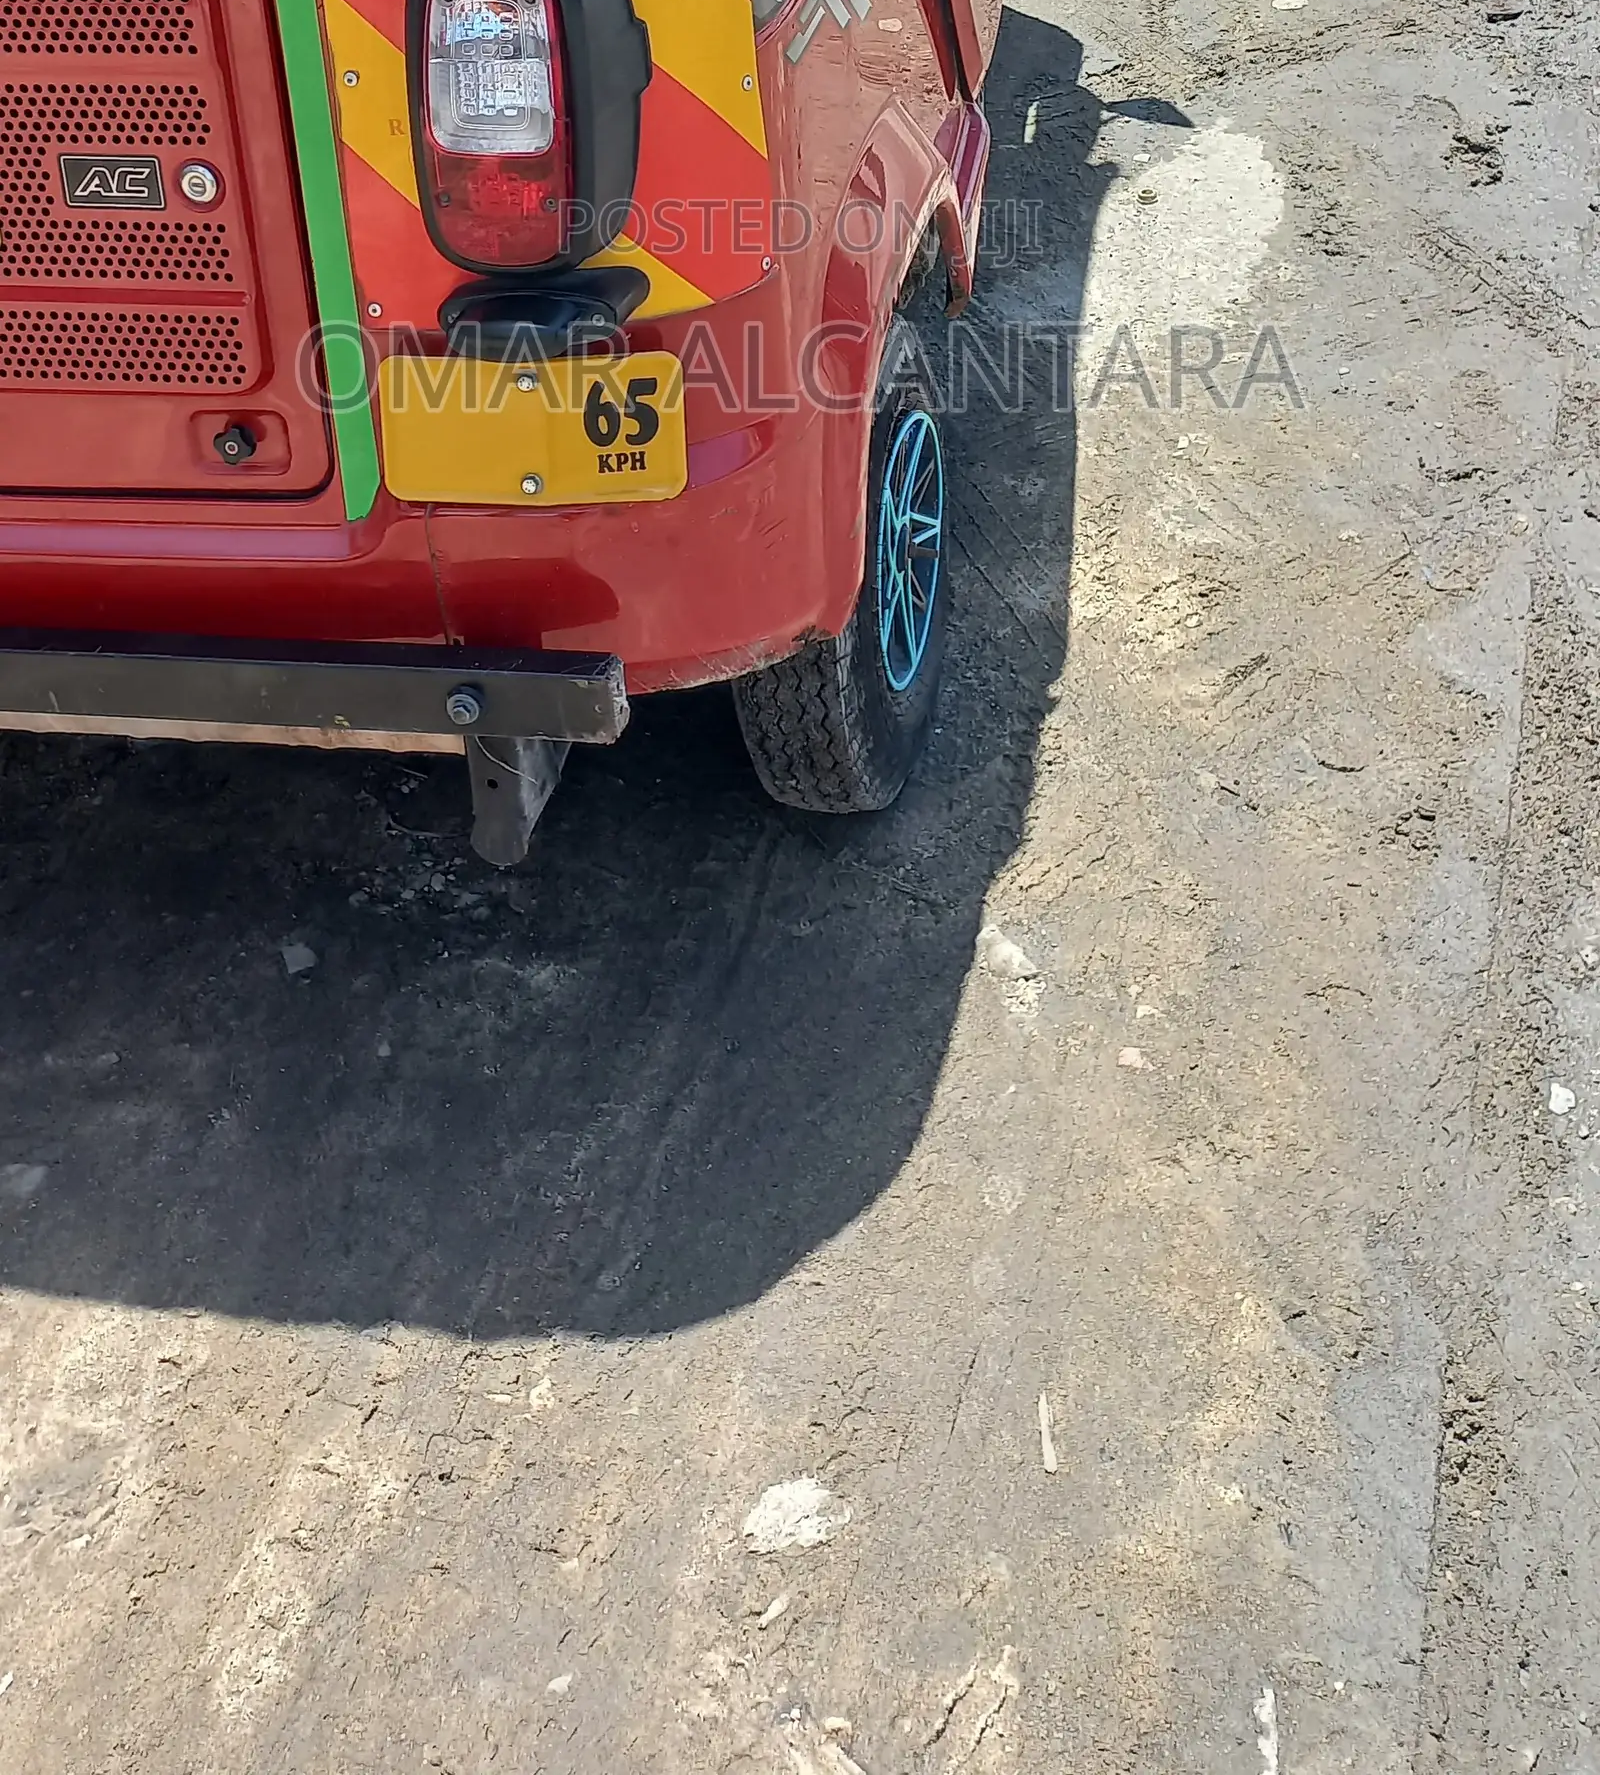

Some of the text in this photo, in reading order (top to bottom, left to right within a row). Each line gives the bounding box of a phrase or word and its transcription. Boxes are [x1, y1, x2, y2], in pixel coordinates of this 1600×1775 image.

[73, 166, 152, 197] AC
[583, 377, 660, 447] 65
[597, 451, 647, 474] KPH
